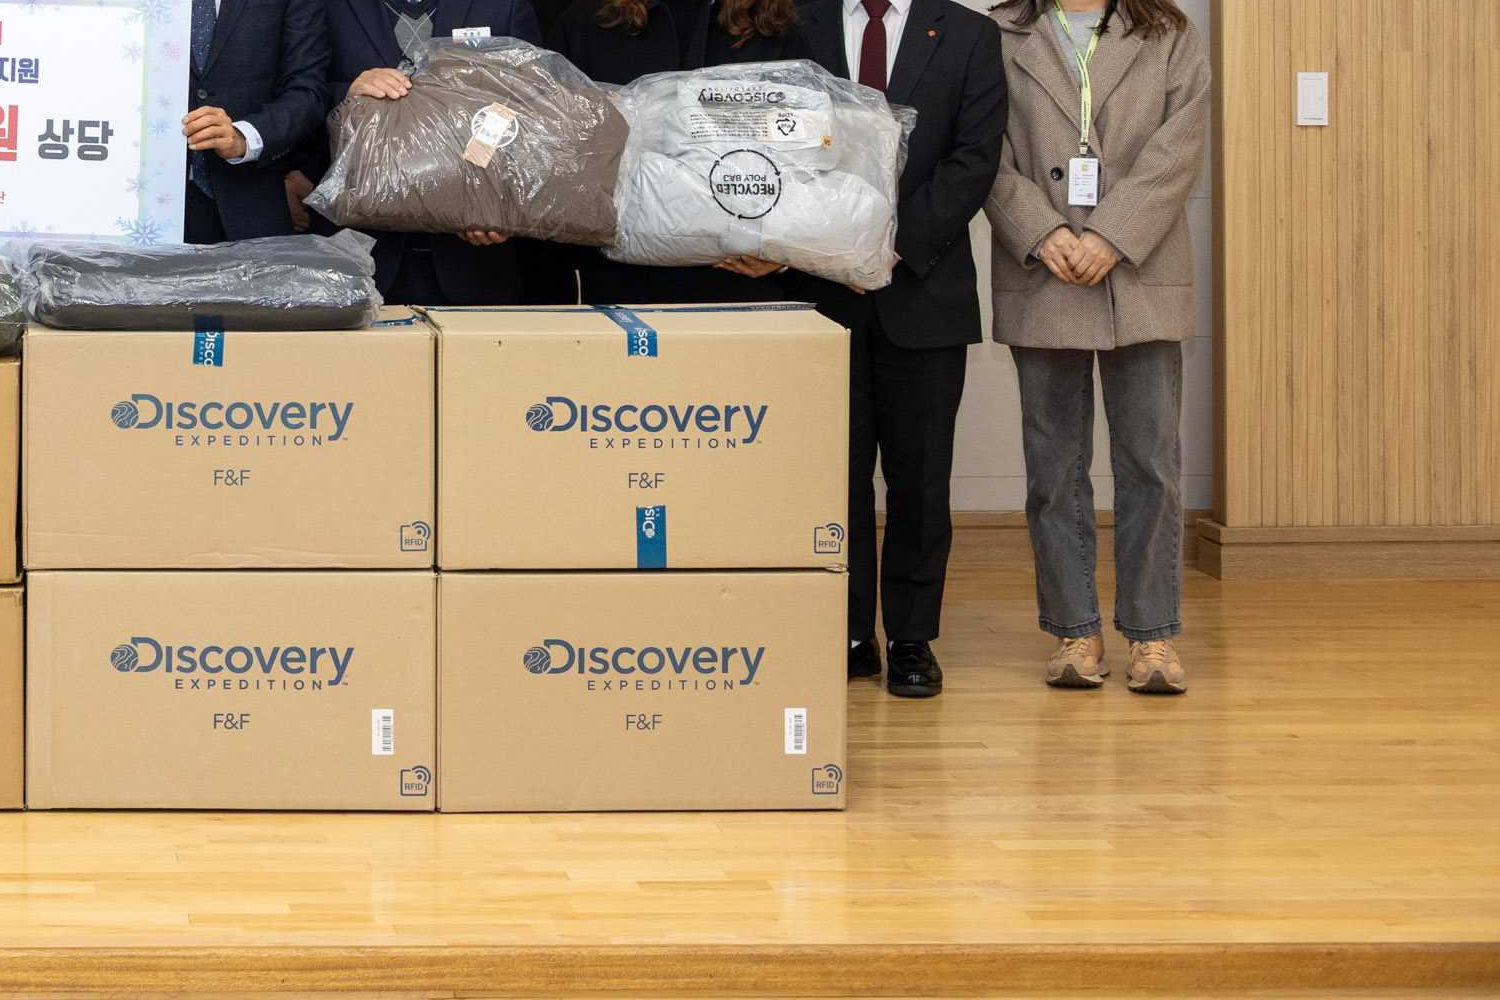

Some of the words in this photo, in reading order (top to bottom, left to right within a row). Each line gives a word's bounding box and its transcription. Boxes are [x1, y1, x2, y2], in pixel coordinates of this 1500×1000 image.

[698, 89, 779, 103] Discovery
[38, 119, 113, 161] 상당
[722, 174, 742, 182] BAG
[743, 174, 767, 182] POLY
[716, 183, 775, 195] RECYCLED
[130, 394, 354, 442] Discovery
[545, 397, 768, 444] Discovery
[176, 435, 321, 445] EXPEDITION
[590, 438, 736, 448] EXPEDITION
[214, 469, 250, 486] F&F
[629, 472, 664, 488] F&F
[404, 538, 424, 546] RFID
[818, 540, 837, 548] RFID
[130, 637, 354, 686] Discovery
[542, 639, 765, 688] Discovery
[175, 679, 321, 690] EXPEDITION
[588, 680, 733, 690] EXPEDITION
[214, 713, 250, 729] F&F
[626, 714, 662, 730] F&F
[405, 781, 425, 790] RFID
